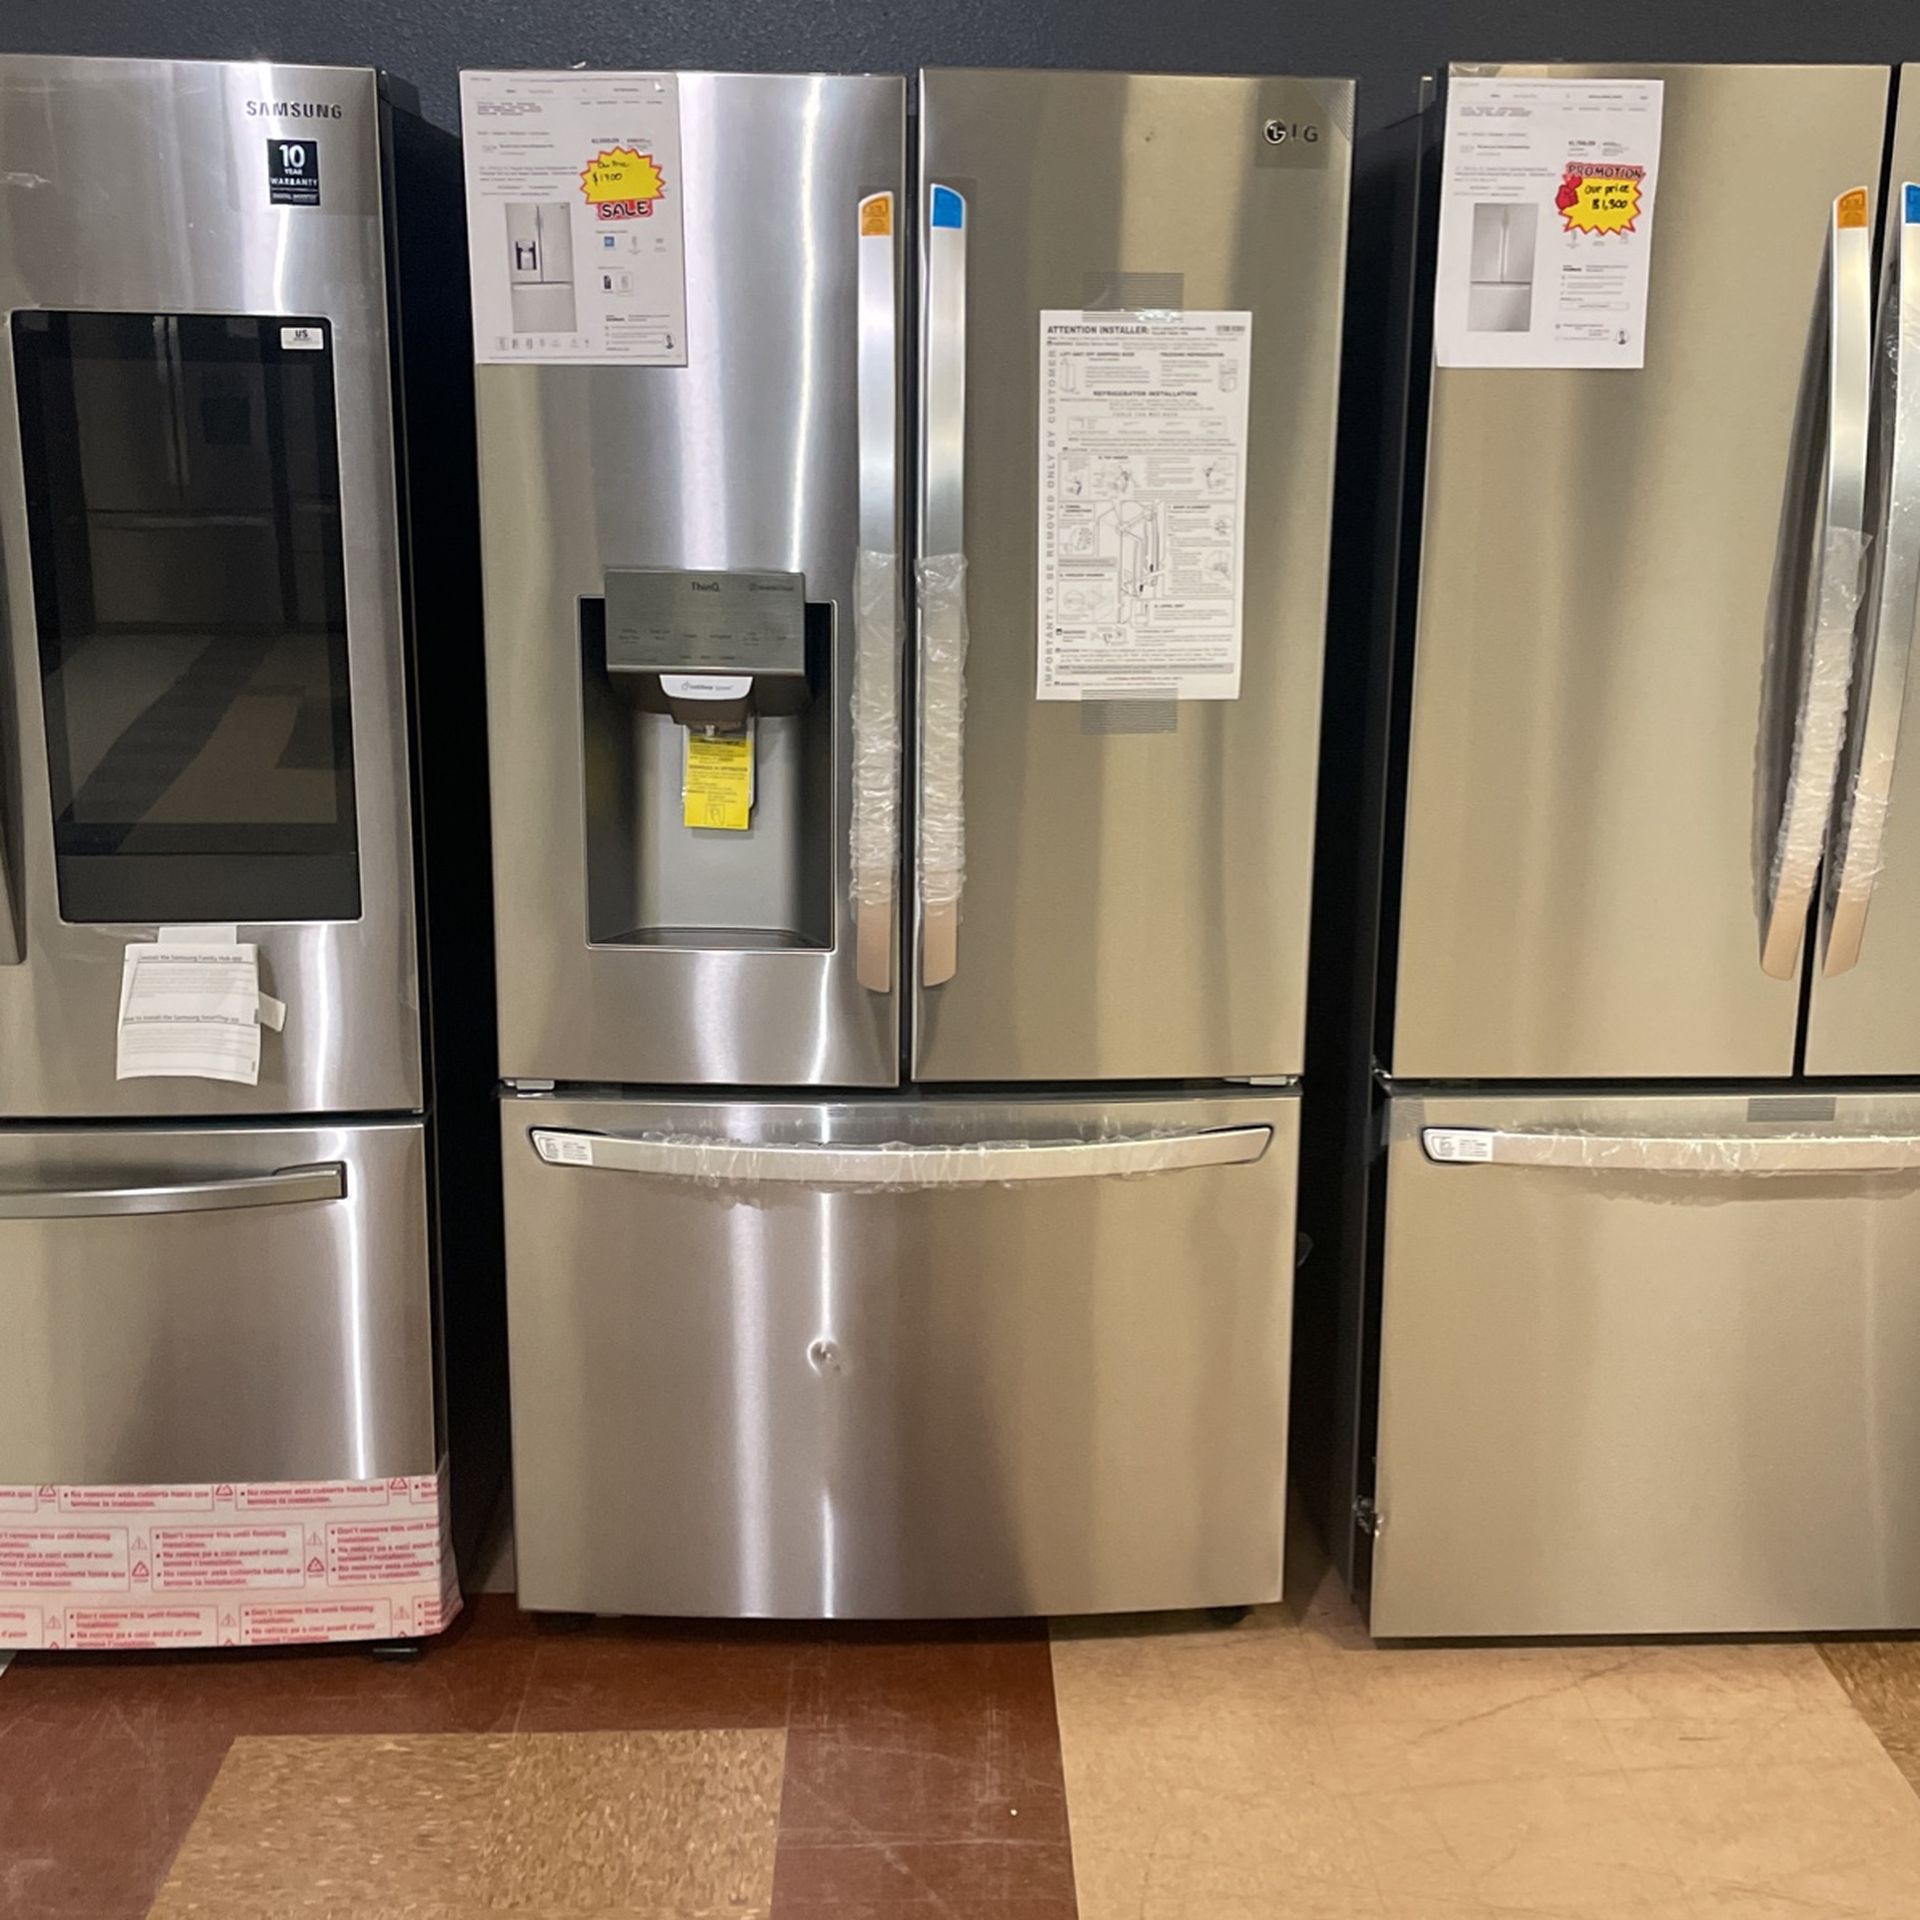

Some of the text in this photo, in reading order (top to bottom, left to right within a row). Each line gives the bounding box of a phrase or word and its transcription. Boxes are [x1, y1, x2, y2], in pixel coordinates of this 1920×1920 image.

[246, 101, 342, 119] SAMSUNG
[279, 144, 305, 168] 10
[284, 168, 303, 176] YEAR
[1567, 164, 1642, 180] PROMOTION
[270, 178, 318, 186] WARRANTY
[1584, 183, 1630, 197] Our price
[602, 200, 649, 218] SALE
[295, 329, 309, 338] US
[1047, 325, 1098, 335] ATTENTION
[1045, 350, 1057, 687] IMPORTANT: TO BE REMOVED ONLY BY CUSTOMER
[691, 582, 720, 592] ThinQ
